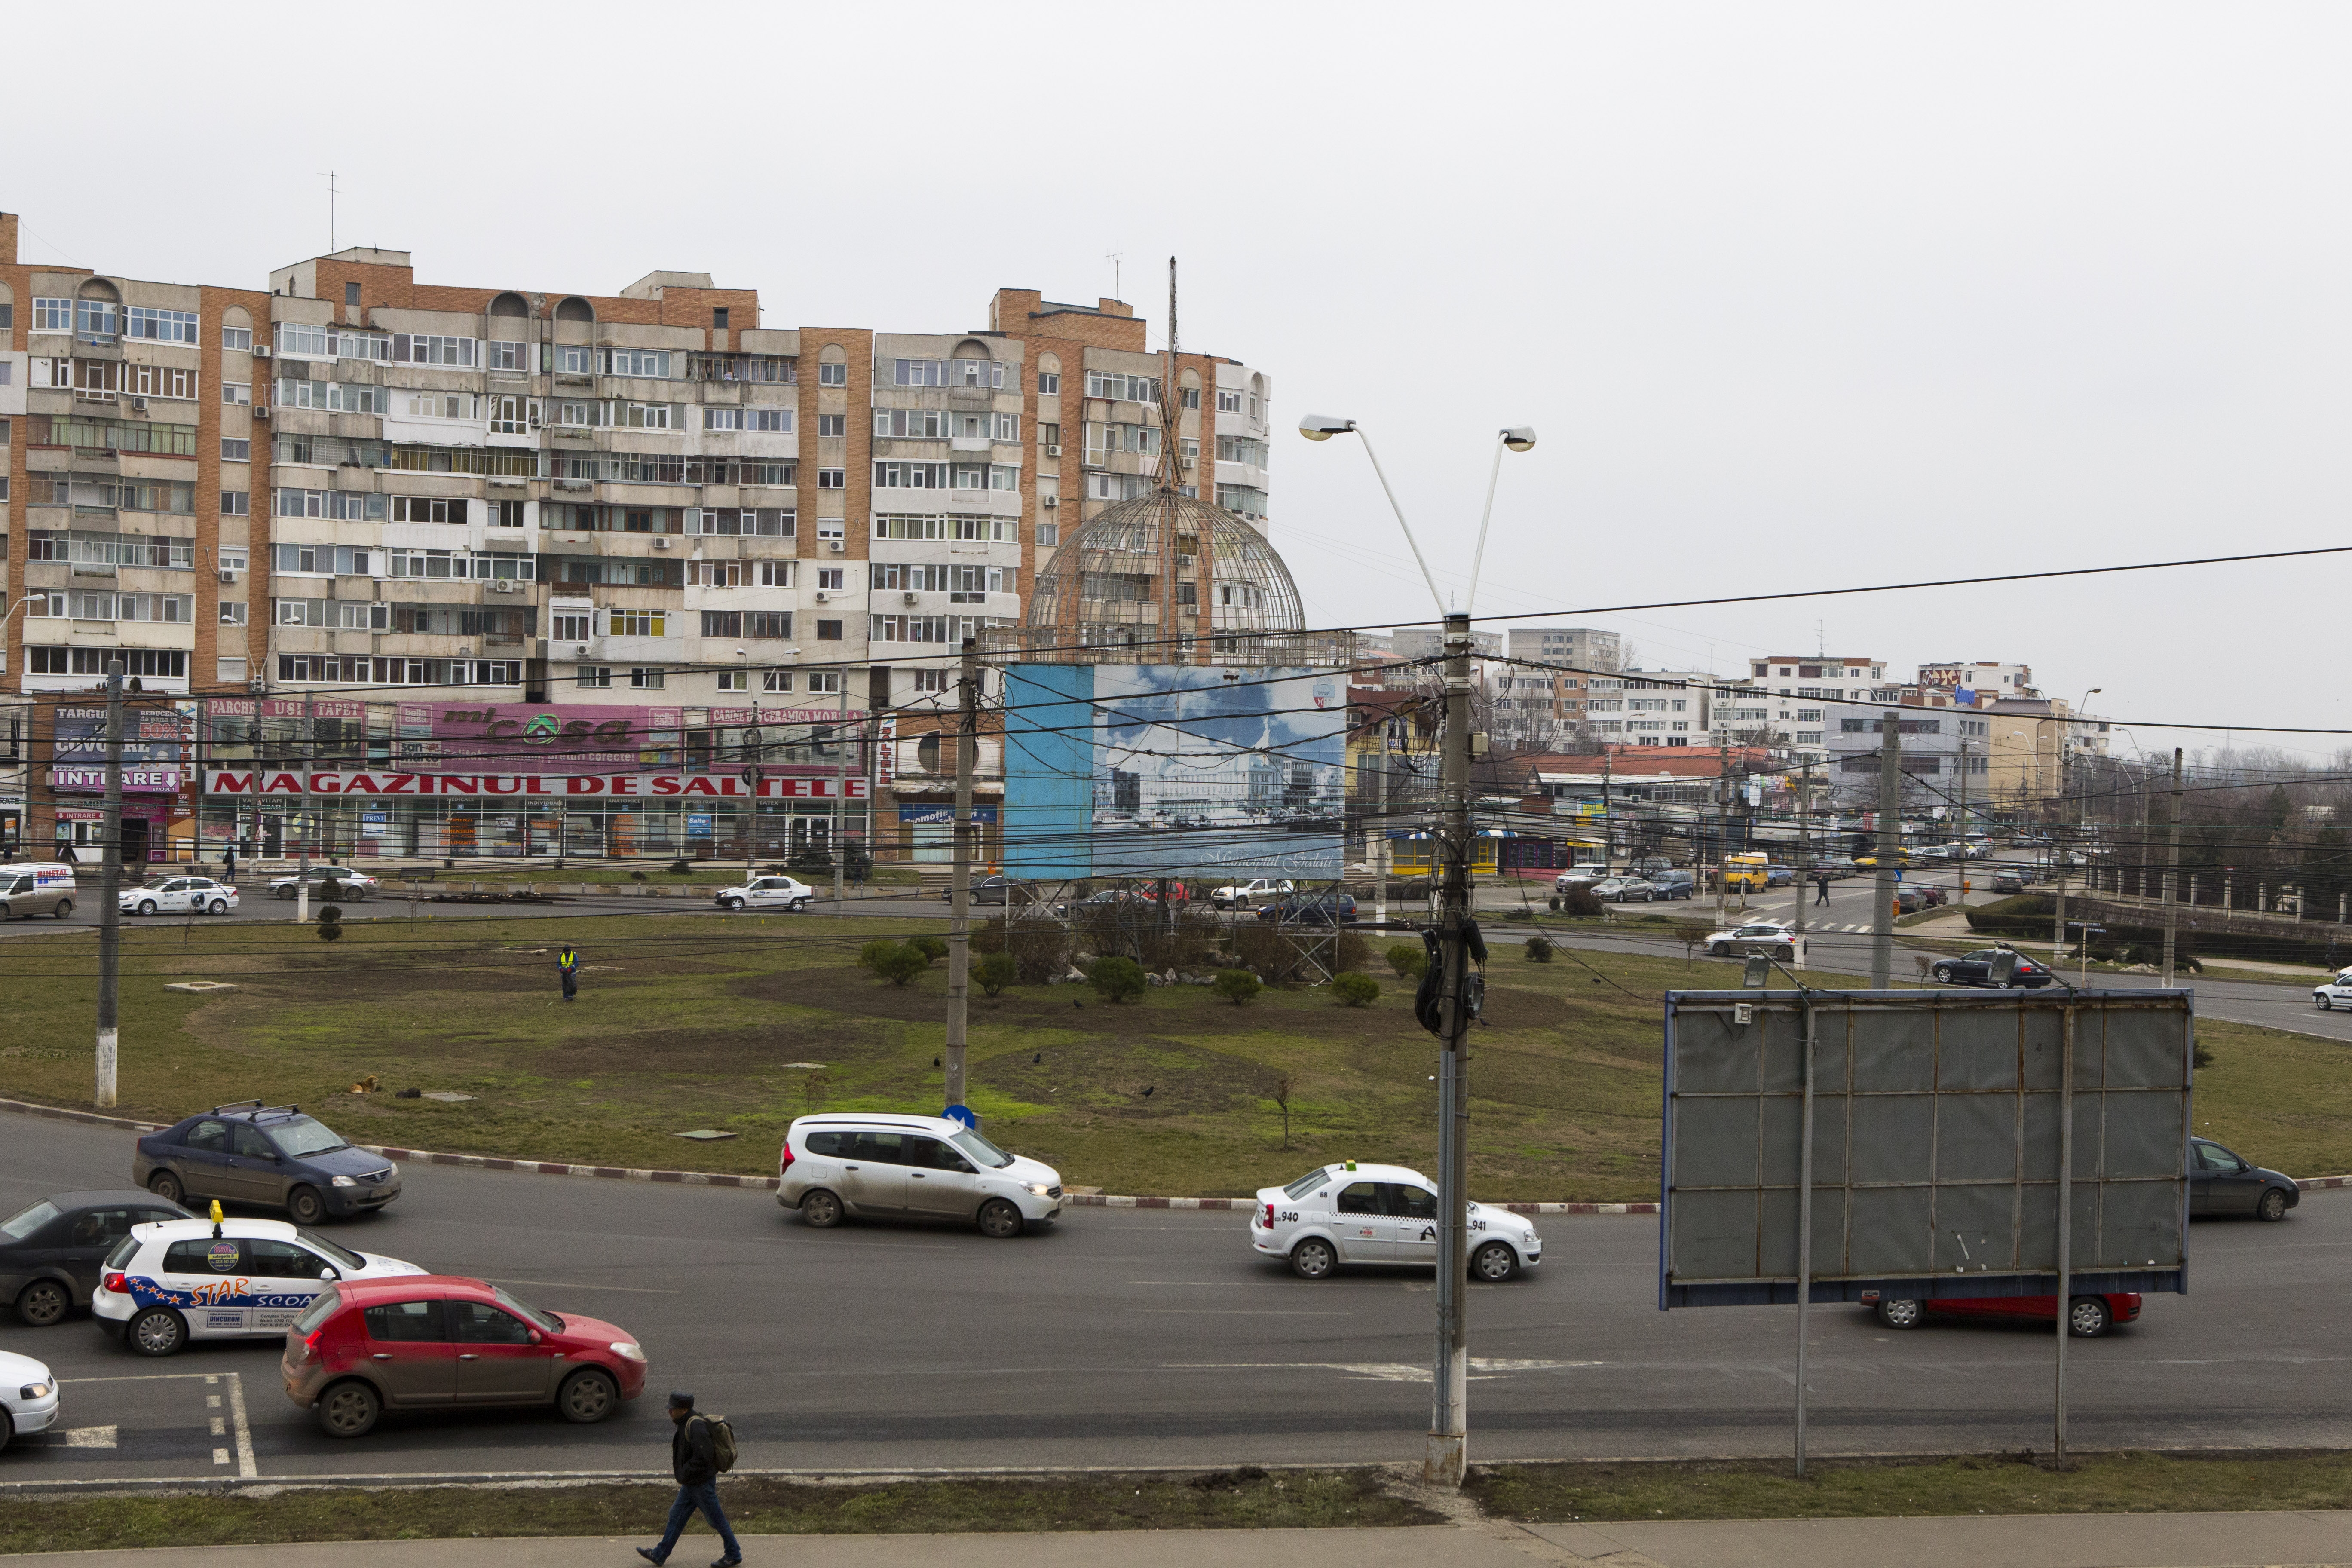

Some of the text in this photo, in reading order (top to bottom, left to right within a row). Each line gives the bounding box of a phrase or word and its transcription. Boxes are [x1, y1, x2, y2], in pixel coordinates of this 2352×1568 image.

[57, 708, 107, 719] TARGU
[211, 701, 359, 715] PARCHE USI TAPET
[714, 710, 858, 723] CABINE DS CERAMICA MOBA
[139, 723, 178, 738] 50%
[56, 738, 150, 753] COVORE
[180, 717, 194, 779] SALTELE
[401, 743, 422, 752] san
[589, 753, 634, 762] corecte!
[879, 726, 893, 784] SALTELE
[58, 772, 162, 785] INTARE
[213, 773, 865, 797] MAGAZINUL DE SALTELE
[1282, 1211, 1298, 1222] 940
[1473, 1220, 1486, 1231] 941
[190, 1278, 251, 1305] STAR
[257, 1295, 313, 1307] SCOA
